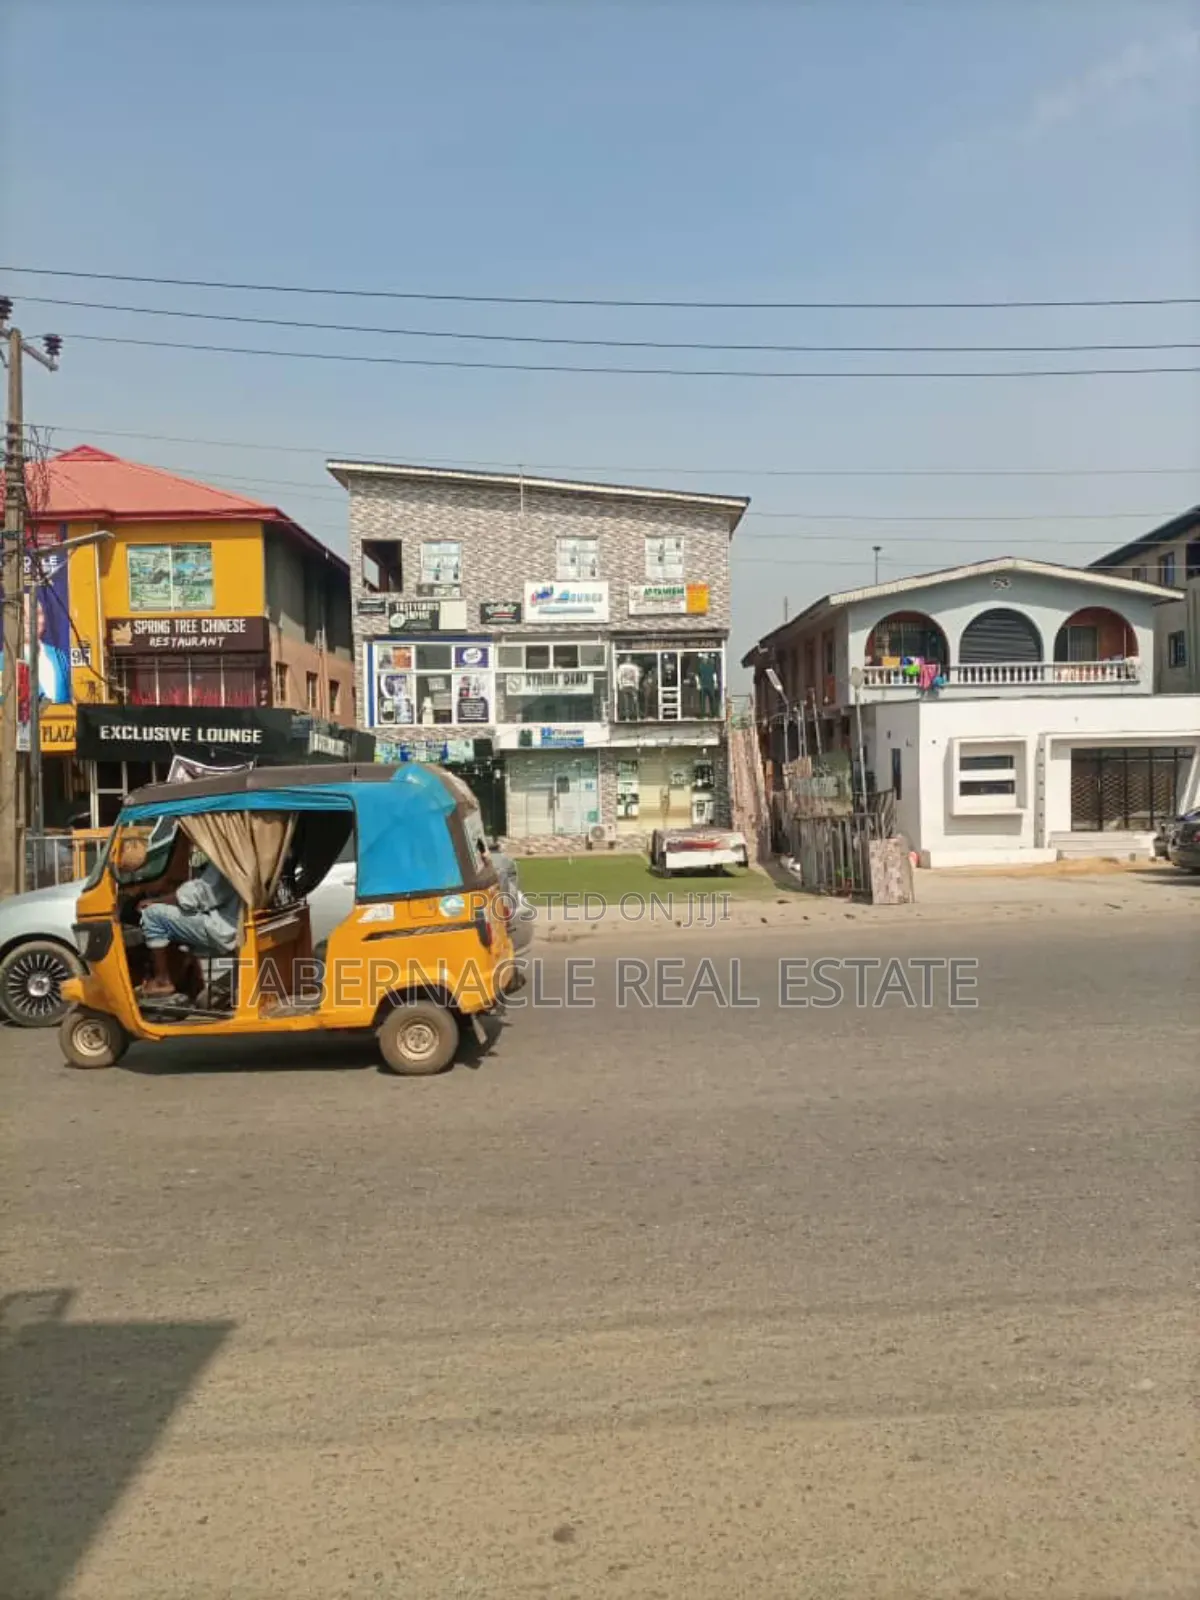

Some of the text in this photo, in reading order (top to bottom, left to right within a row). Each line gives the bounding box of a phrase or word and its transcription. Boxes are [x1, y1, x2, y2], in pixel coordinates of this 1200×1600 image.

[133, 618, 246, 634] SPRING TREE CHINESE
[149, 636, 226, 648] RESTAURANT
[100, 725, 263, 744] EXCLUSIVE LOUNGE
